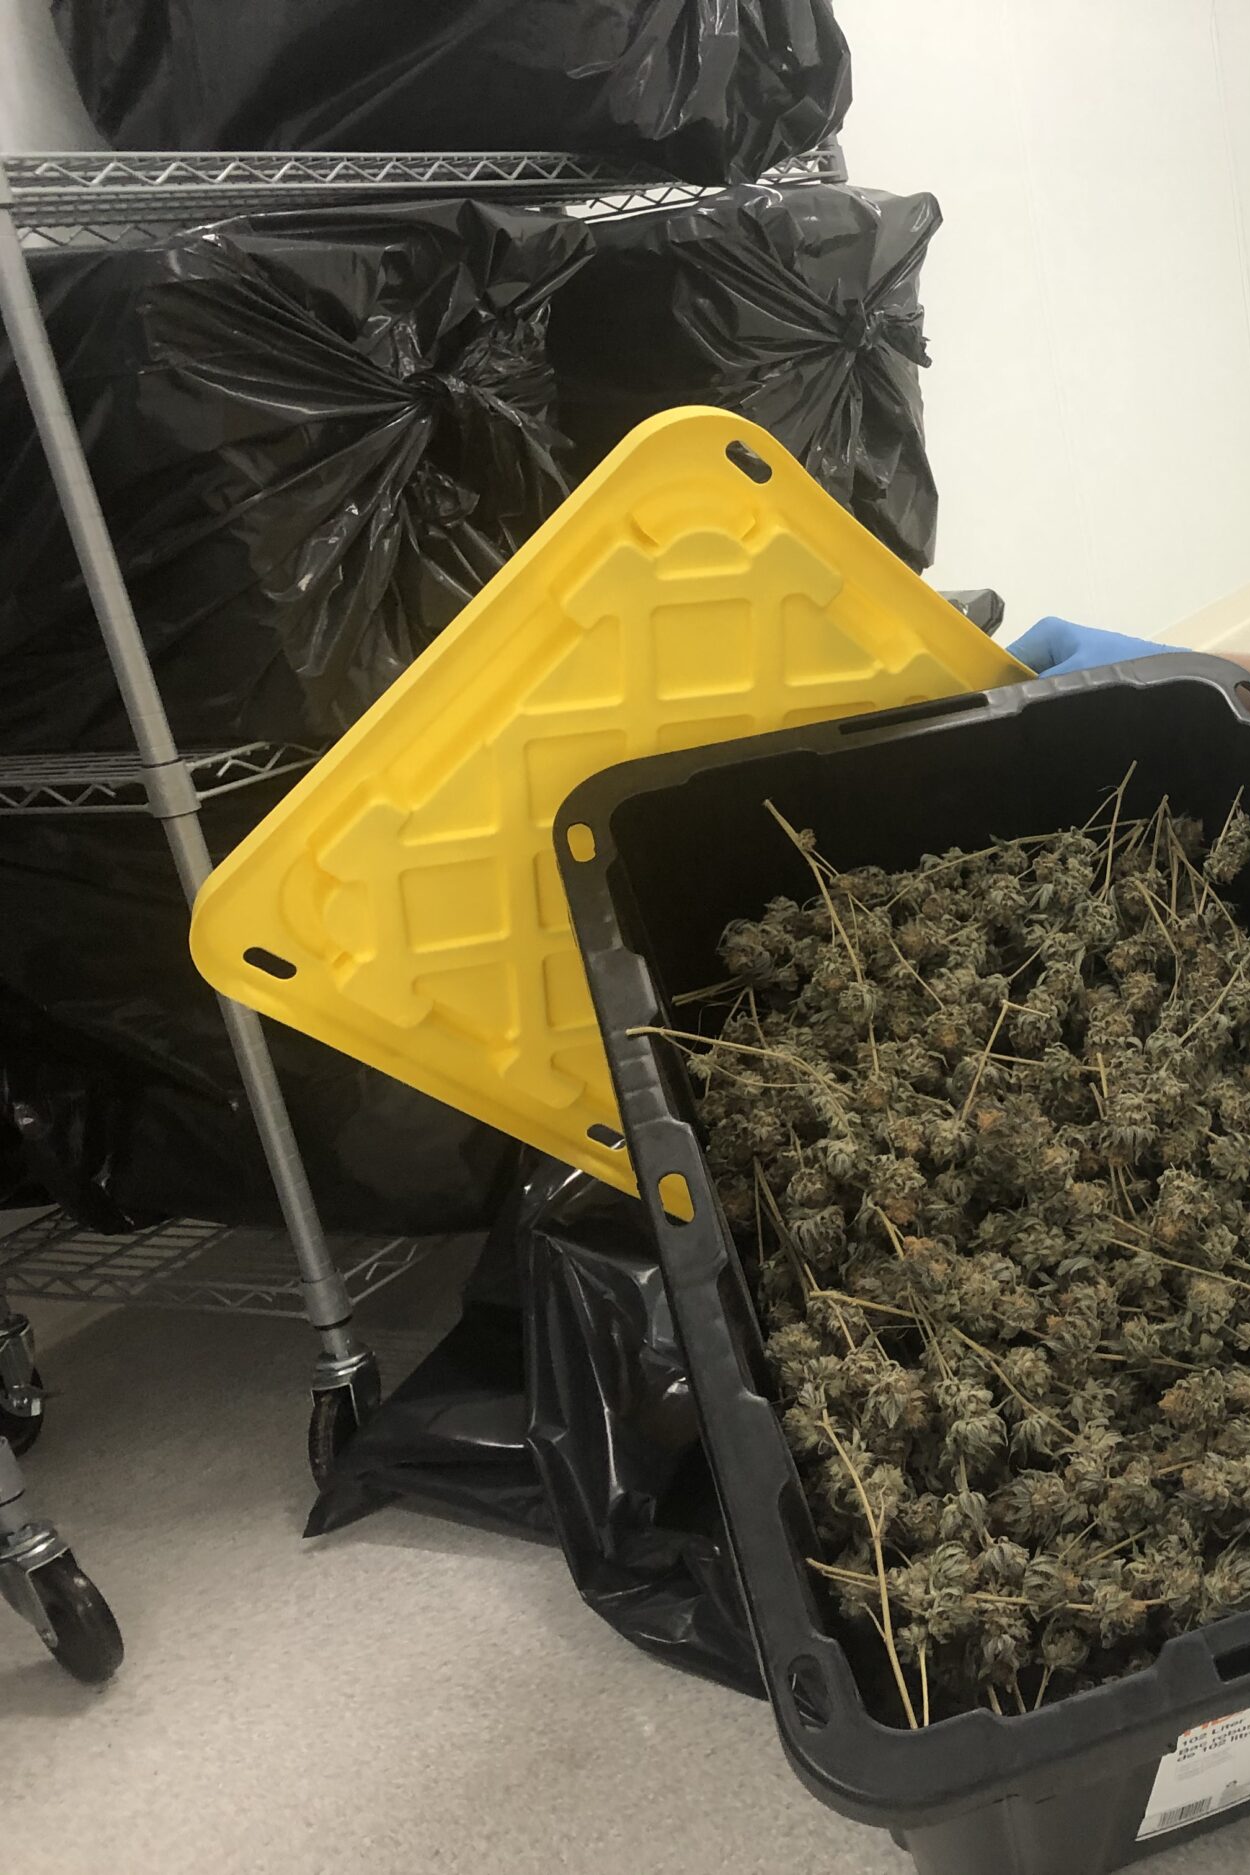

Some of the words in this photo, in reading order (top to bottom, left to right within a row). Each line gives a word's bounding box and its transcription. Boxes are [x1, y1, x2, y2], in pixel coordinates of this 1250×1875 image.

[1182, 1732, 1208, 1746] 102
[1212, 1719, 1243, 1735] Liter
[1177, 1752, 1196, 1762] de
[1203, 1739, 1227, 1752] 102
[1178, 1741, 1208, 1756] Bac
